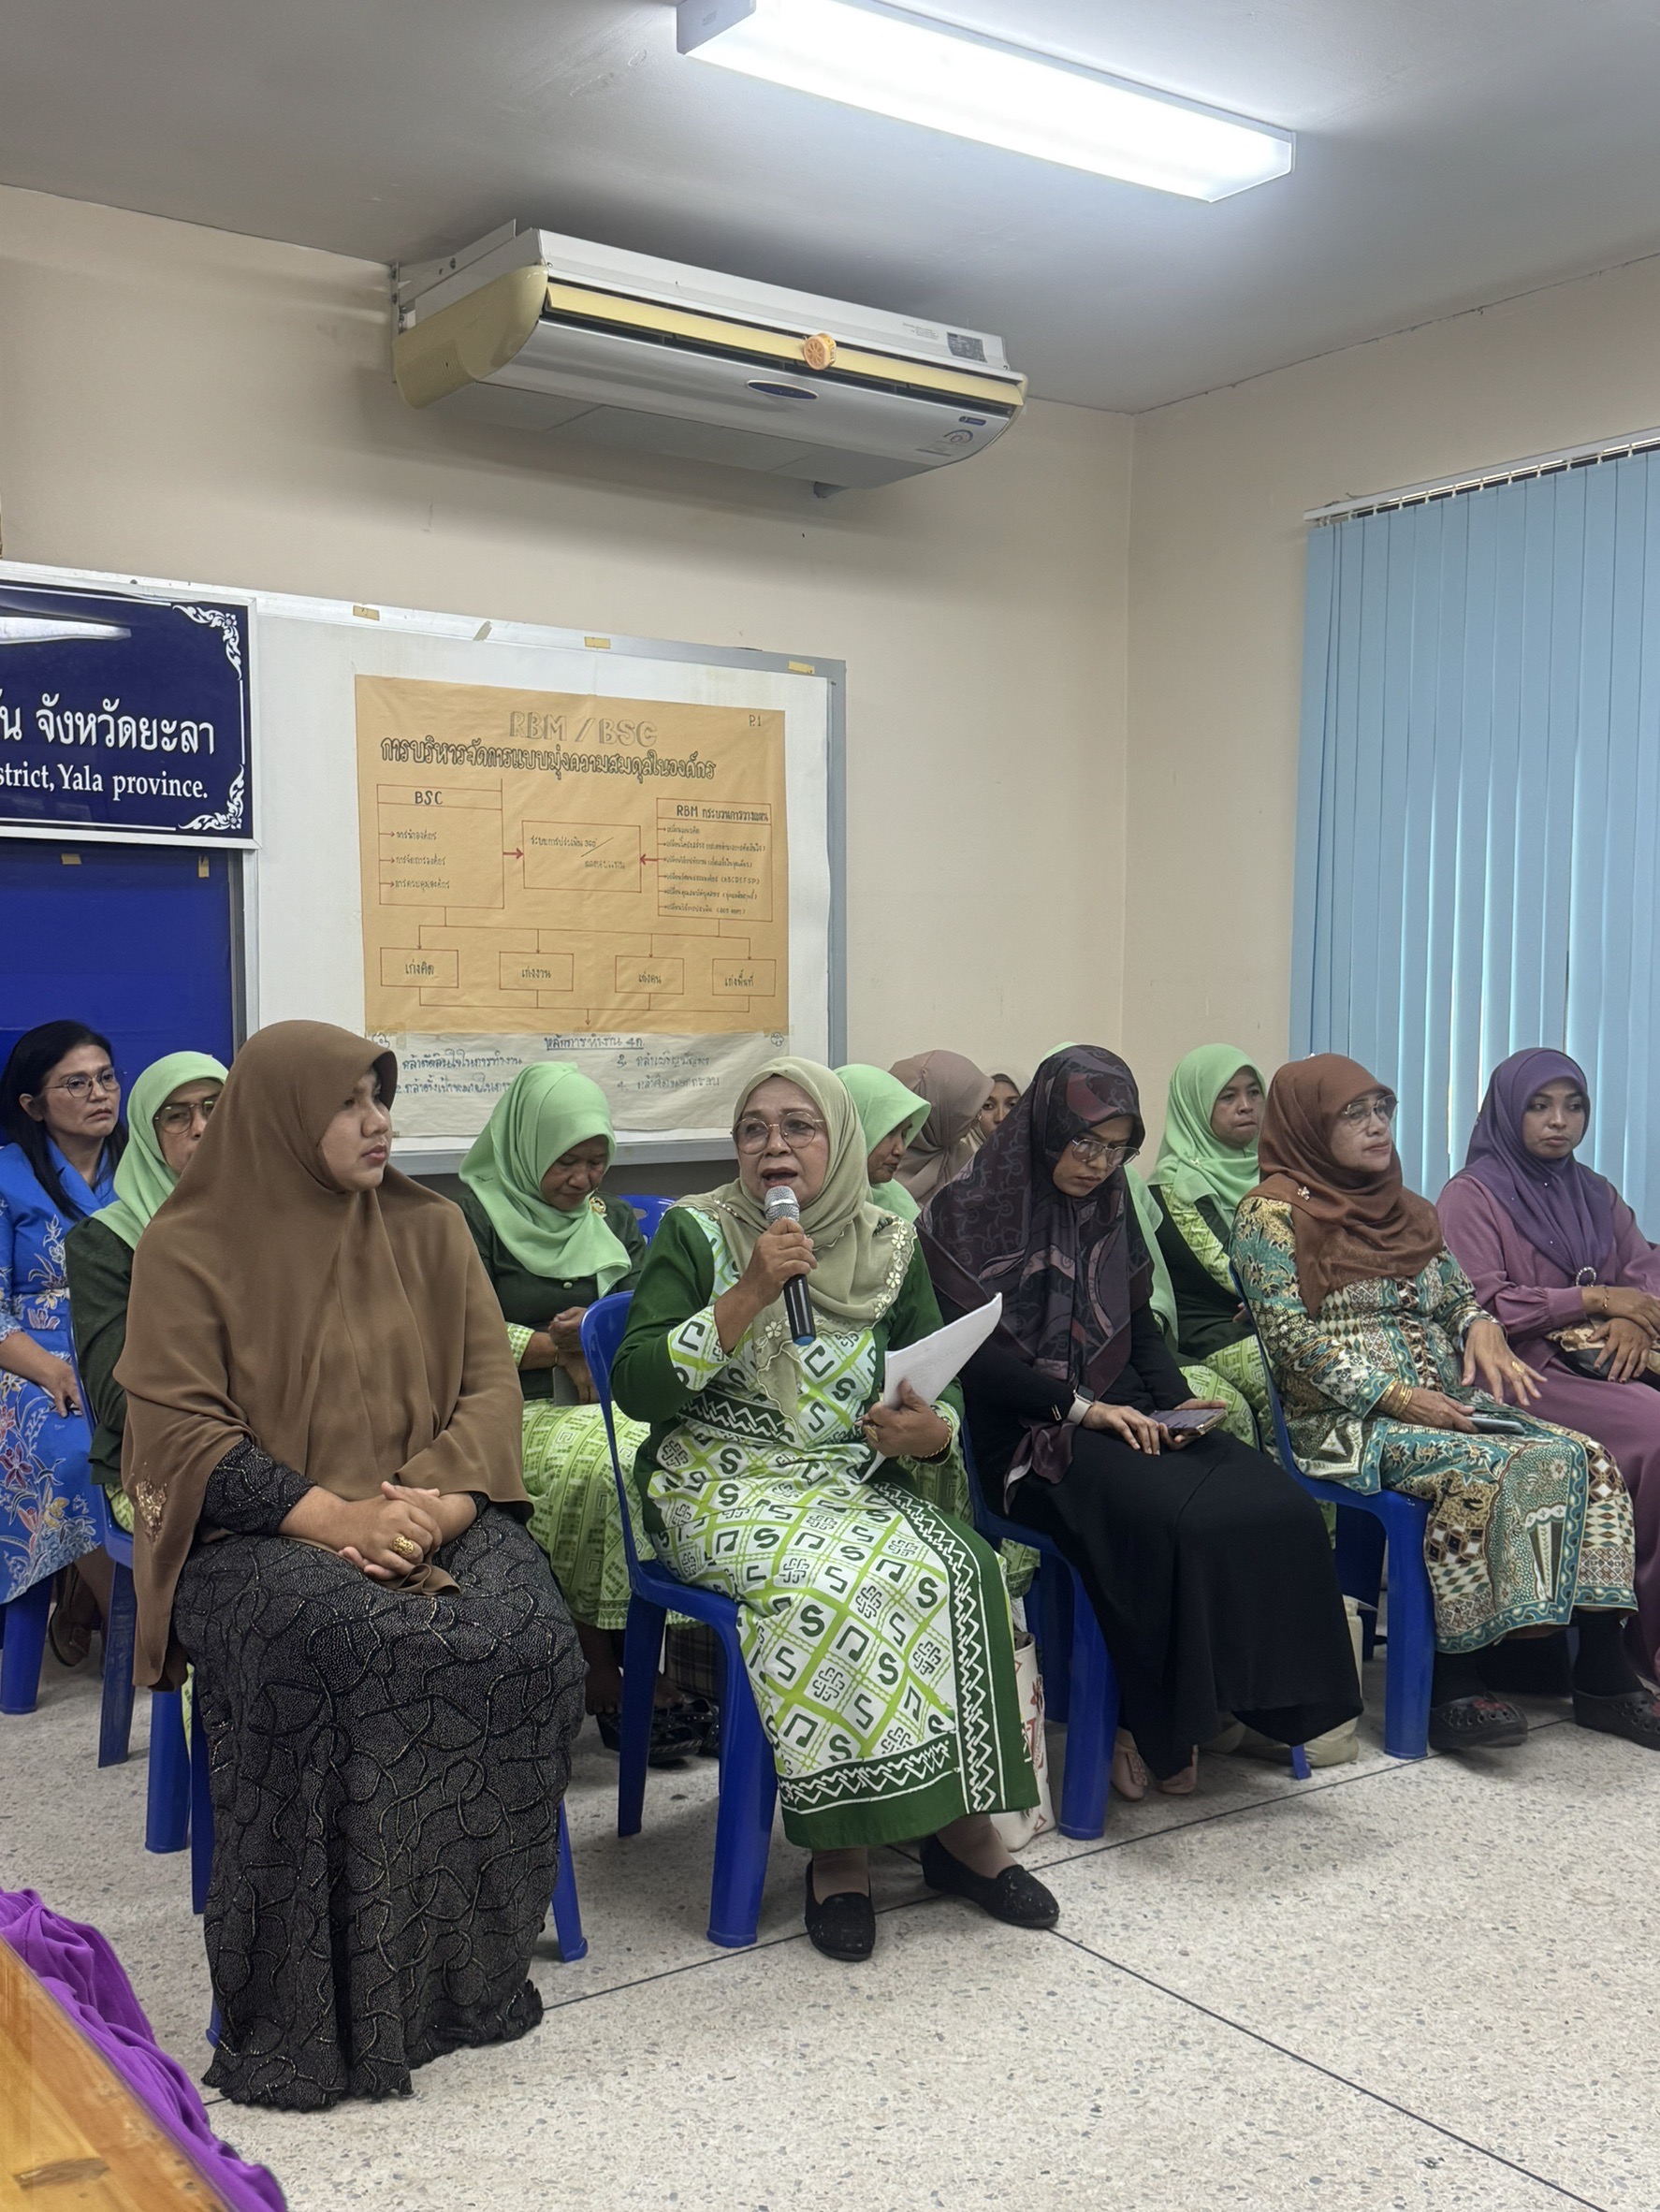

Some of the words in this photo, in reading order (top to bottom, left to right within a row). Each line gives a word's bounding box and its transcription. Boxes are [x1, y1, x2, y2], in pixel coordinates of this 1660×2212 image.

[36, 692, 214, 754] จังหวัดยะลา
[749, 714, 762, 727] P.1
[509, 711, 567, 741] RBM
[599, 718, 658, 748] BSC
[58, 764, 104, 792] Yala
[112, 770, 208, 801] province.
[415, 790, 443, 805] BSC
[677, 805, 698, 817] RBM
[405, 959, 434, 975] เก่งคิด
[521, 966, 551, 979] เก่งงาน
[638, 971, 662, 983] เก่งคน
